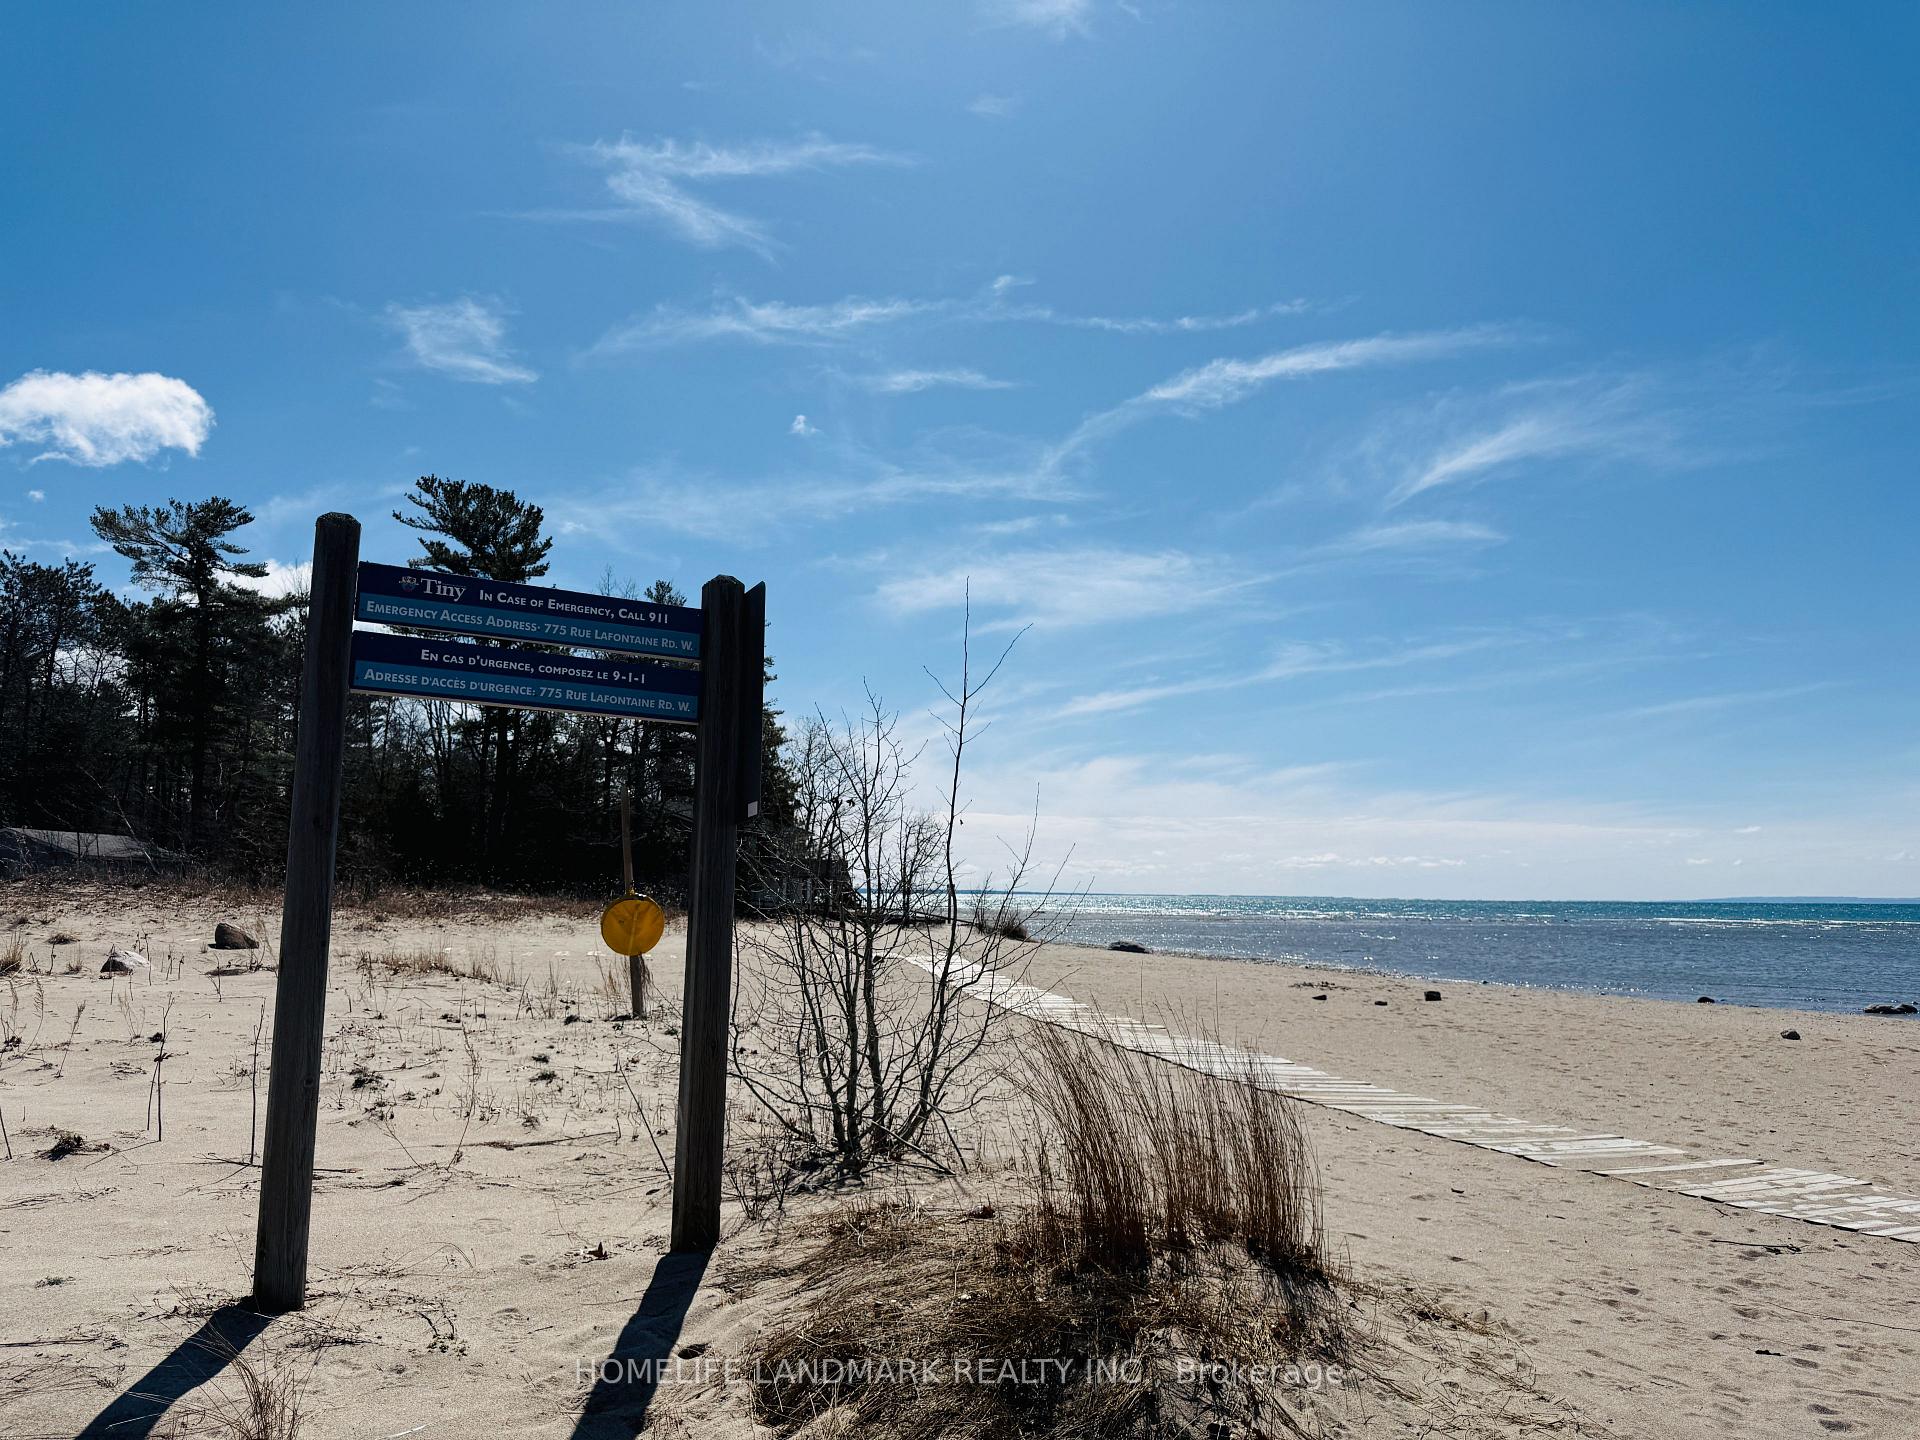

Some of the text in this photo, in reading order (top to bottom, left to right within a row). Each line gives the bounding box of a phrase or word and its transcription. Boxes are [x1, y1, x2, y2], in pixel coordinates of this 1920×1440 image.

[420, 578, 466, 602] Tiny
[479, 589, 669, 624] IN CASE OF EMERGENCY, CALL 911
[366, 600, 438, 620] EMERGENCY
[440, 609, 483, 625] ACCESS
[544, 623, 567, 636] 775
[570, 627, 592, 639] RUE
[594, 630, 659, 647] LAFONTAINE
[661, 638, 678, 649] RD.
[681, 641, 693, 651] W.
[420, 649, 439, 662] EN
[442, 654, 464, 665] CAS
[538, 665, 594, 679] COMPOSEZ
[597, 671, 609, 680] LE
[612, 671, 646, 685] 9-1-1
[363, 668, 418, 685] ADRESSE
[539, 687, 563, 698] 775
[566, 690, 587, 701] RUE
[590, 692, 655, 709] LAFONTAINE
[658, 700, 675, 711] RD.
[678, 703, 690, 713] W.
